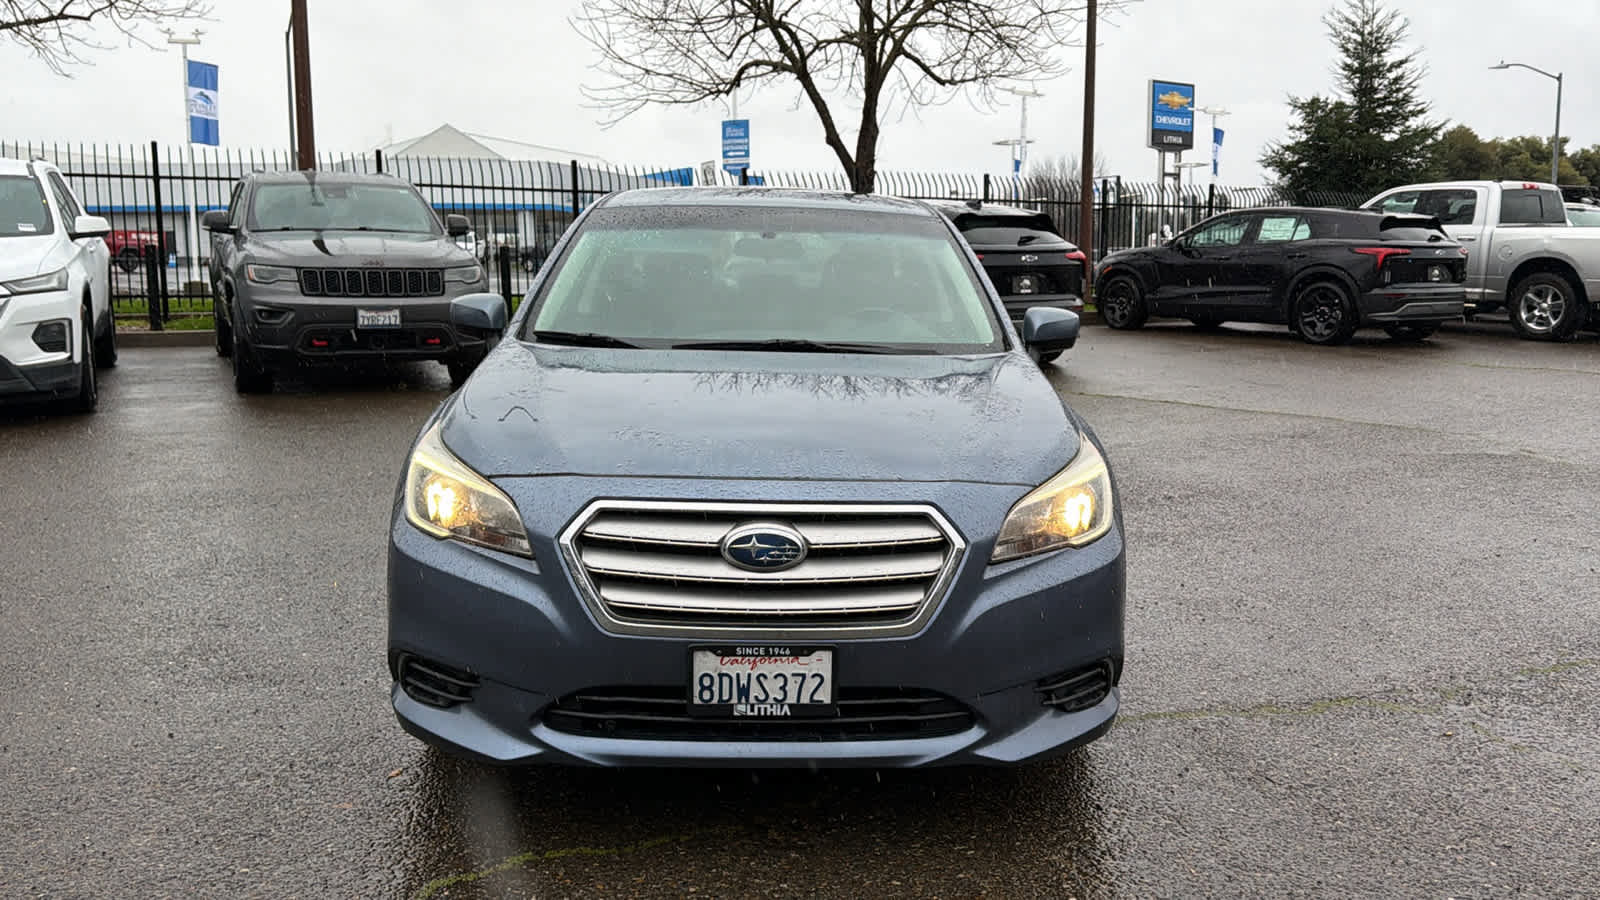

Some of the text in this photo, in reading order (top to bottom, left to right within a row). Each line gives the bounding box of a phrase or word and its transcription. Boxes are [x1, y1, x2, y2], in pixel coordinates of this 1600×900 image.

[1155, 115, 1191, 126] CHEVROLET
[736, 647, 791, 656] SINCE 1946
[698, 672, 825, 704] 8DWS372
[746, 704, 791, 716] LITHIA
